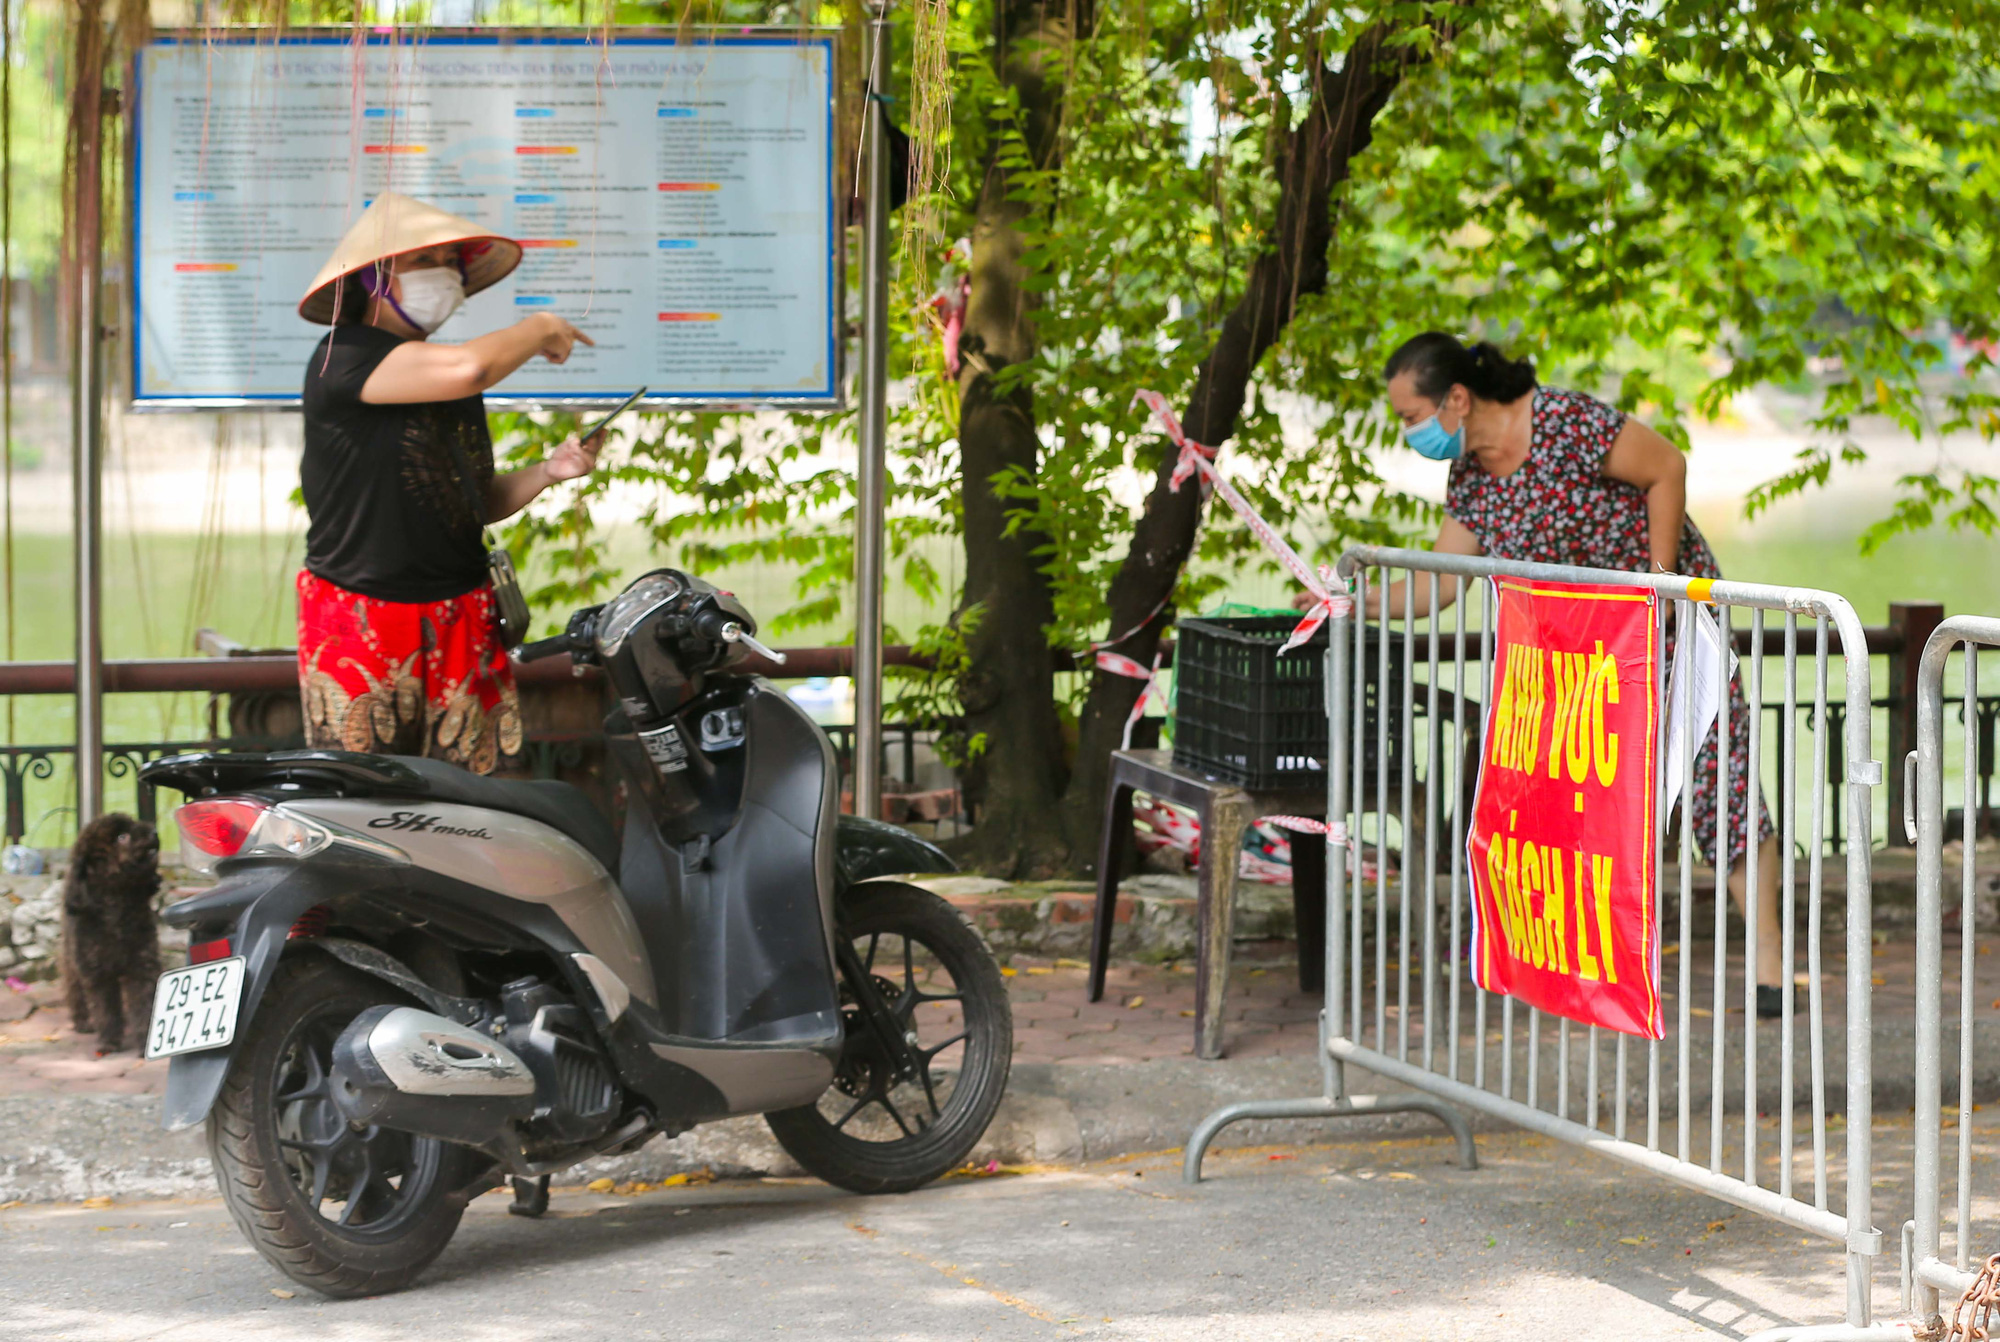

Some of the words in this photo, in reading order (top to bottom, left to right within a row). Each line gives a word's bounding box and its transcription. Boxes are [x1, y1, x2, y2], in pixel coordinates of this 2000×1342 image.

[1491, 642, 1545, 777] KHU
[1548, 640, 1620, 813] VỰC
[1487, 809, 1570, 975] CÁCH
[1574, 851, 1618, 984] LY
[153, 1004, 227, 1052] 347.44
[165, 966, 228, 1012] 29-E2
